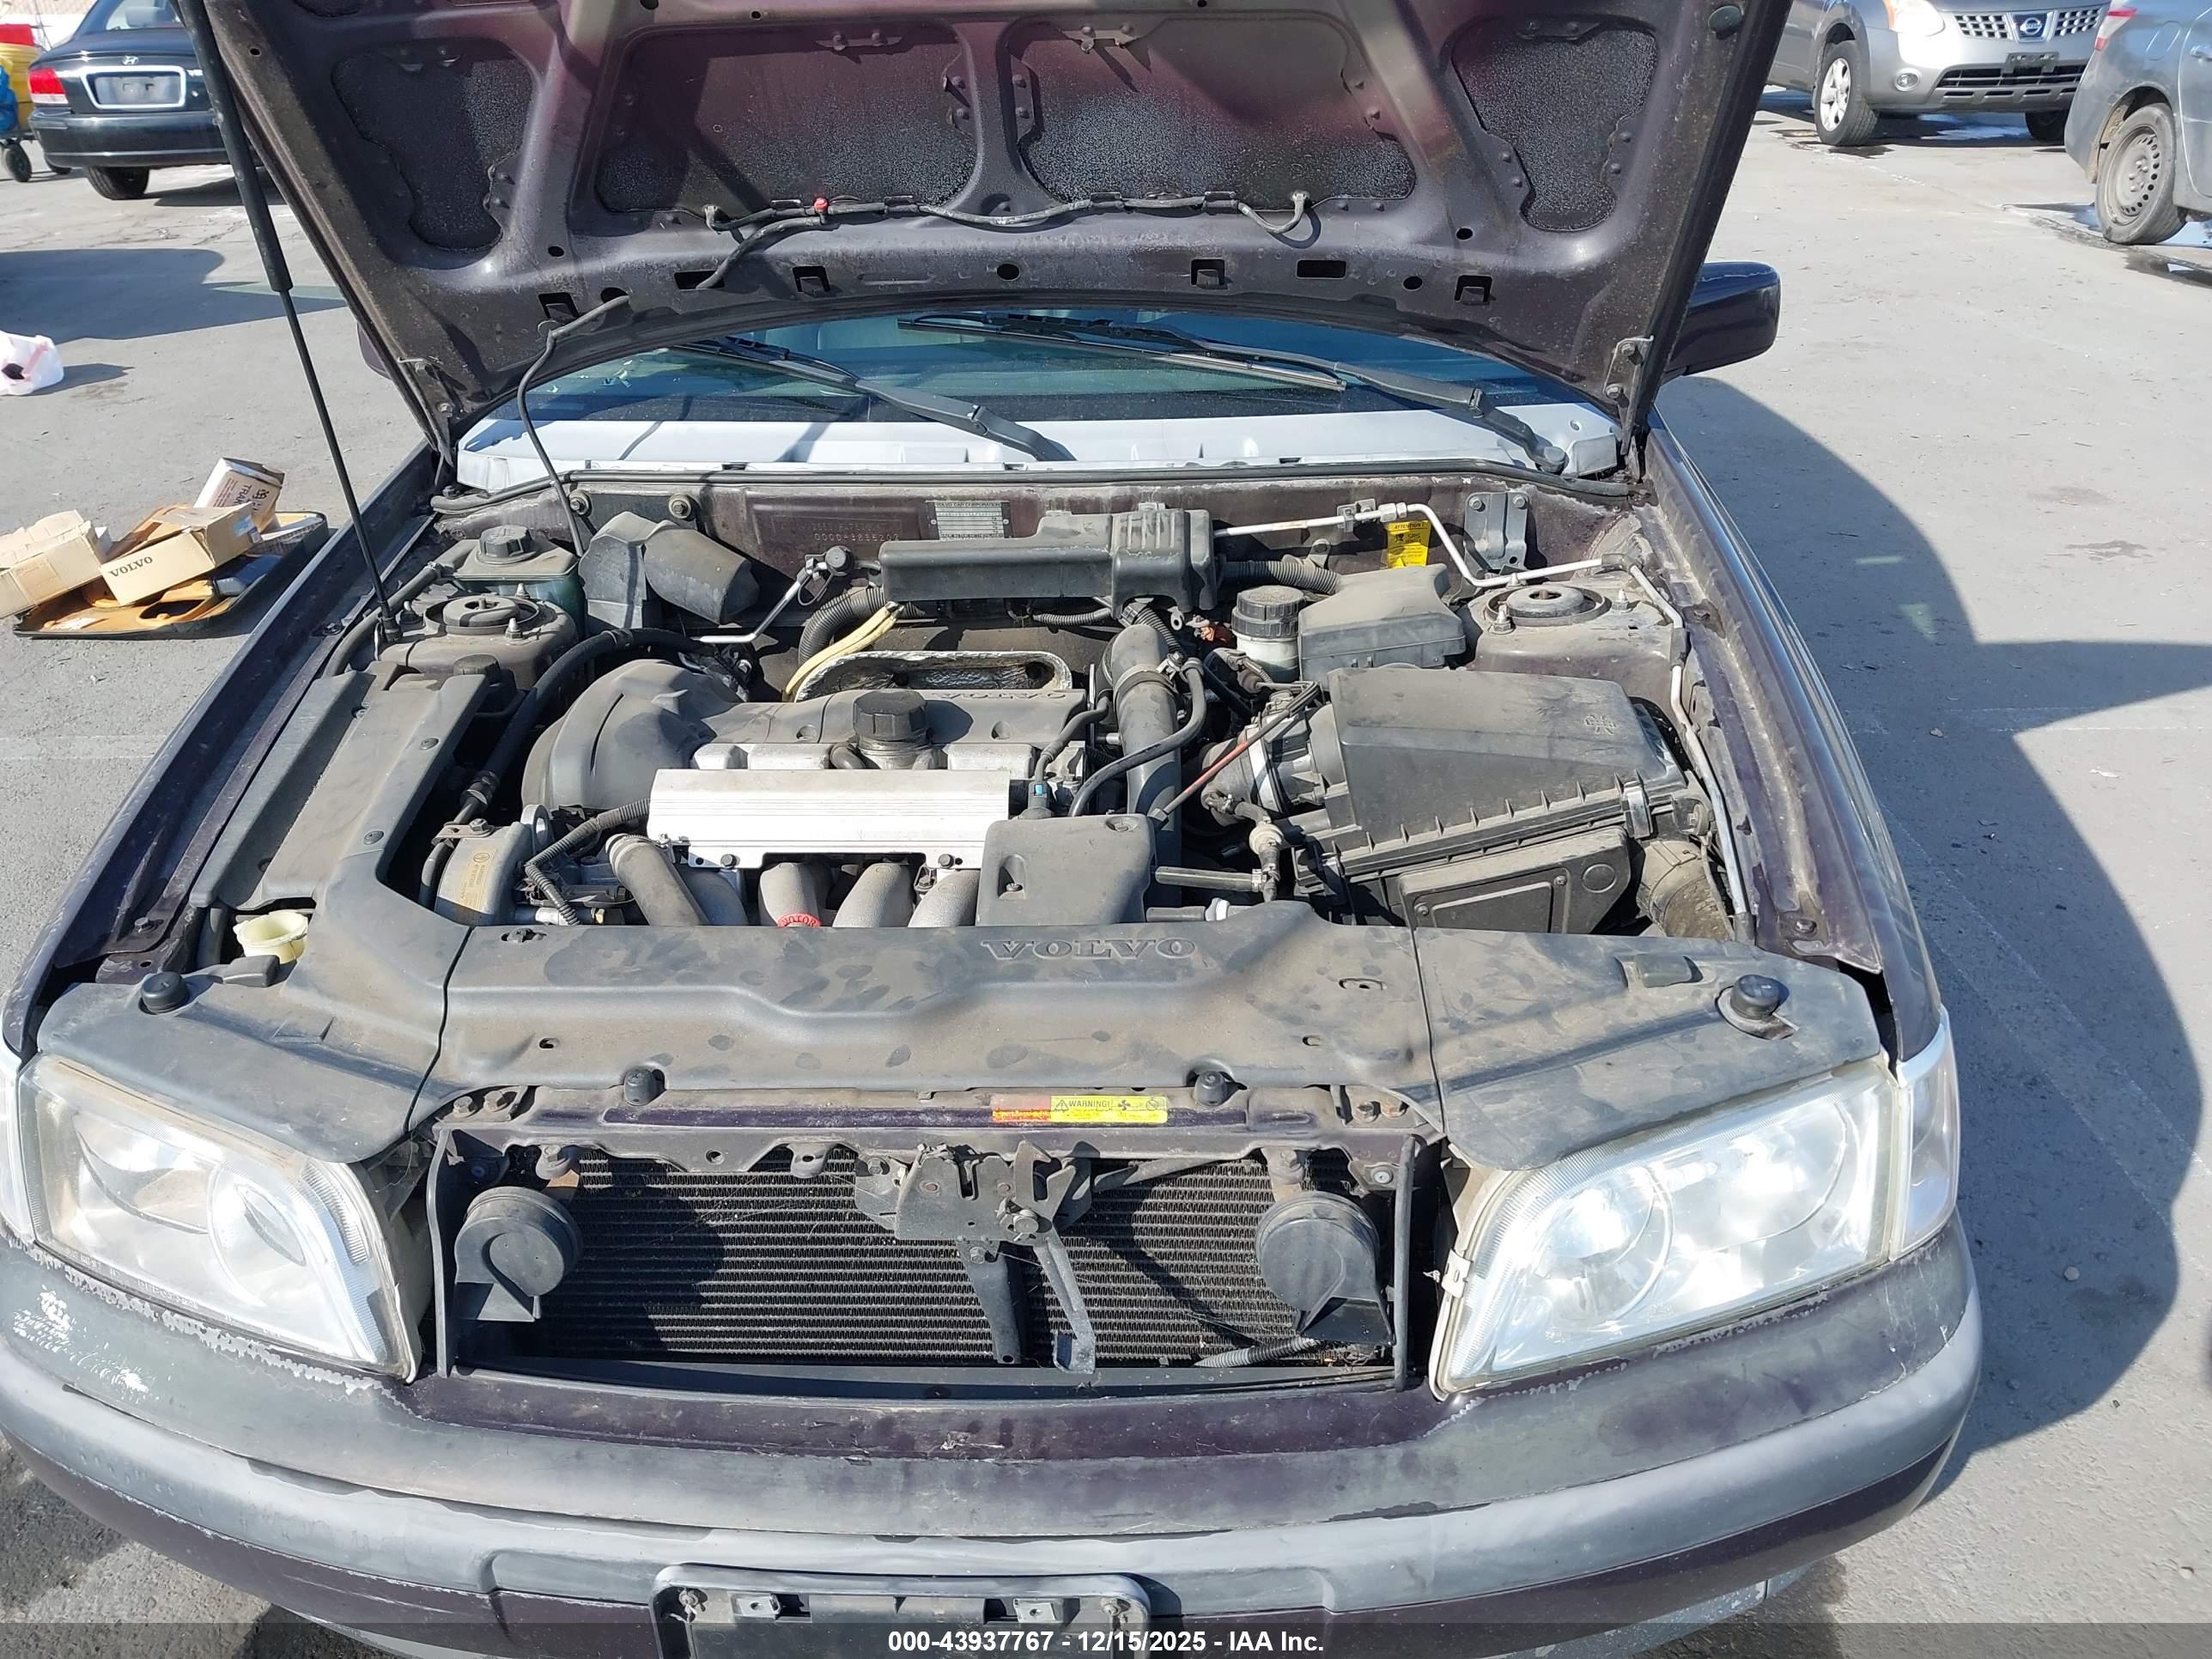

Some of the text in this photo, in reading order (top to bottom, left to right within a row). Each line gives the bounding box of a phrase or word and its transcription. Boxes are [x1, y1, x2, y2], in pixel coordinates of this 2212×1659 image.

[107, 556, 153, 577] VOLVO
[981, 939, 1196, 960] VOLVO
[1068, 1099, 1111, 1108] WARNING!
